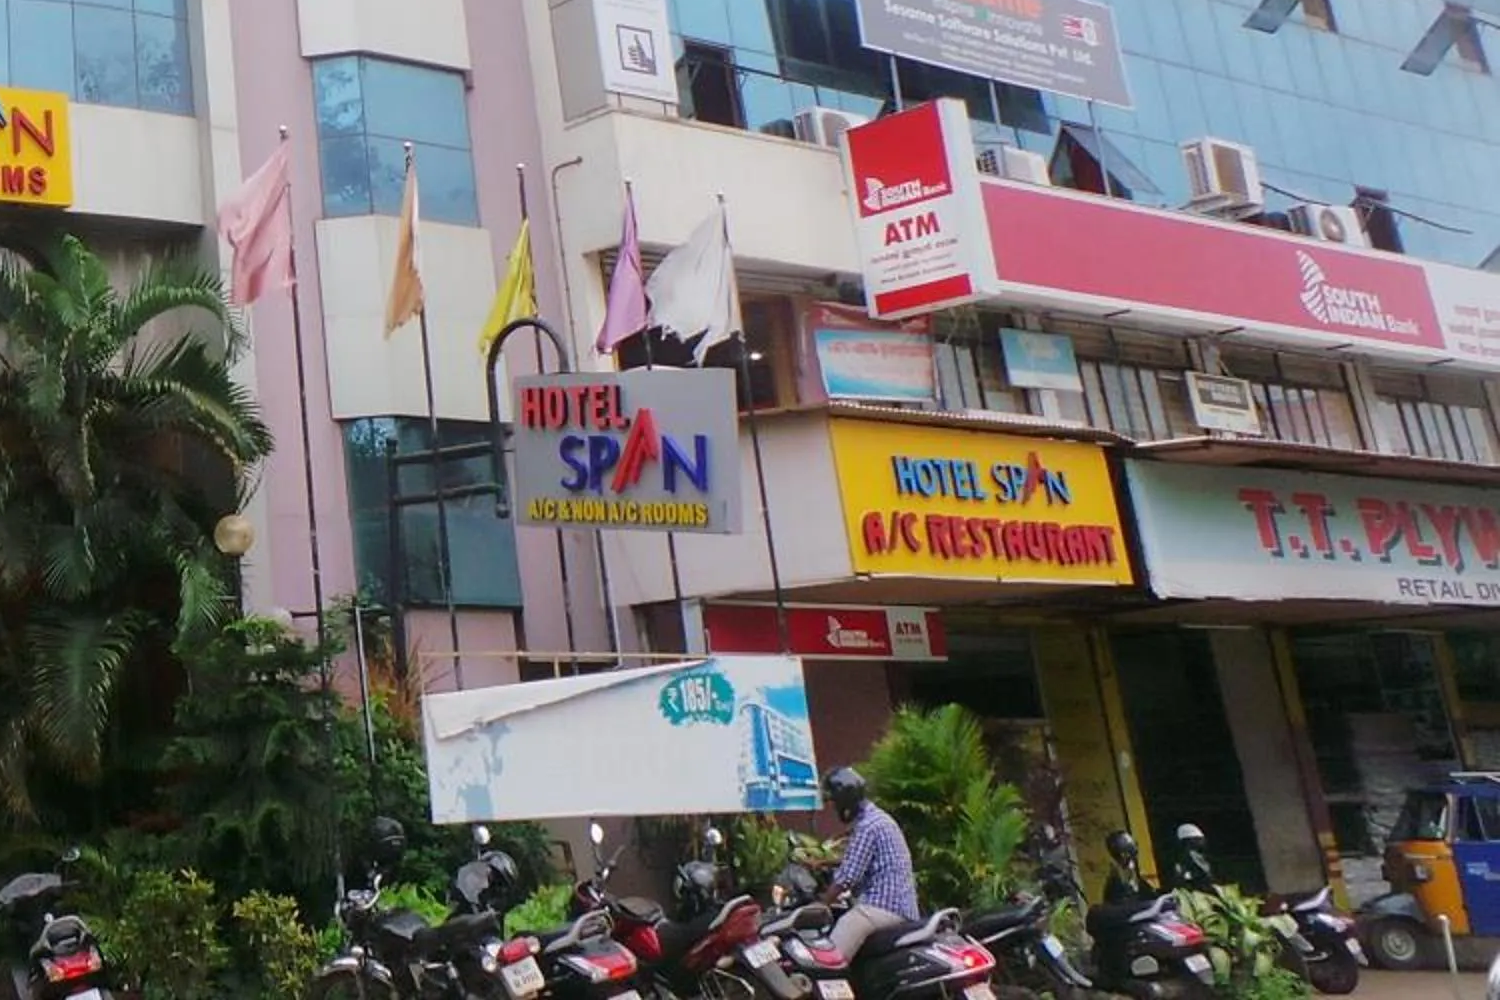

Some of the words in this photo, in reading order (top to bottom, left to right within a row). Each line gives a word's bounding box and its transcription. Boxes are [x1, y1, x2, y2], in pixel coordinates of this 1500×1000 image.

[884, 0, 936, 24] Sesame
[938, 14, 991, 40] Software
[994, 29, 1048, 54] Solutions
[885, 211, 941, 246] ATM
[1322, 283, 1382, 312] SOUTH
[1328, 304, 1386, 330] INDIAN
[520, 384, 630, 430] HOTEL
[560, 408, 709, 495] SPAN
[891, 455, 987, 501] HOTEL
[991, 451, 1072, 506] SPAN
[528, 500, 556, 521] A/C
[558, 501, 571, 521] &
[572, 501, 607, 521] NON
[608, 502, 639, 523] A/C
[641, 502, 709, 526] ROOMS
[862, 511, 921, 555] A/C
[924, 513, 1118, 566] RESTAURANT
[1398, 577, 1474, 600] RETAIL
[896, 620, 922, 636] ATM
